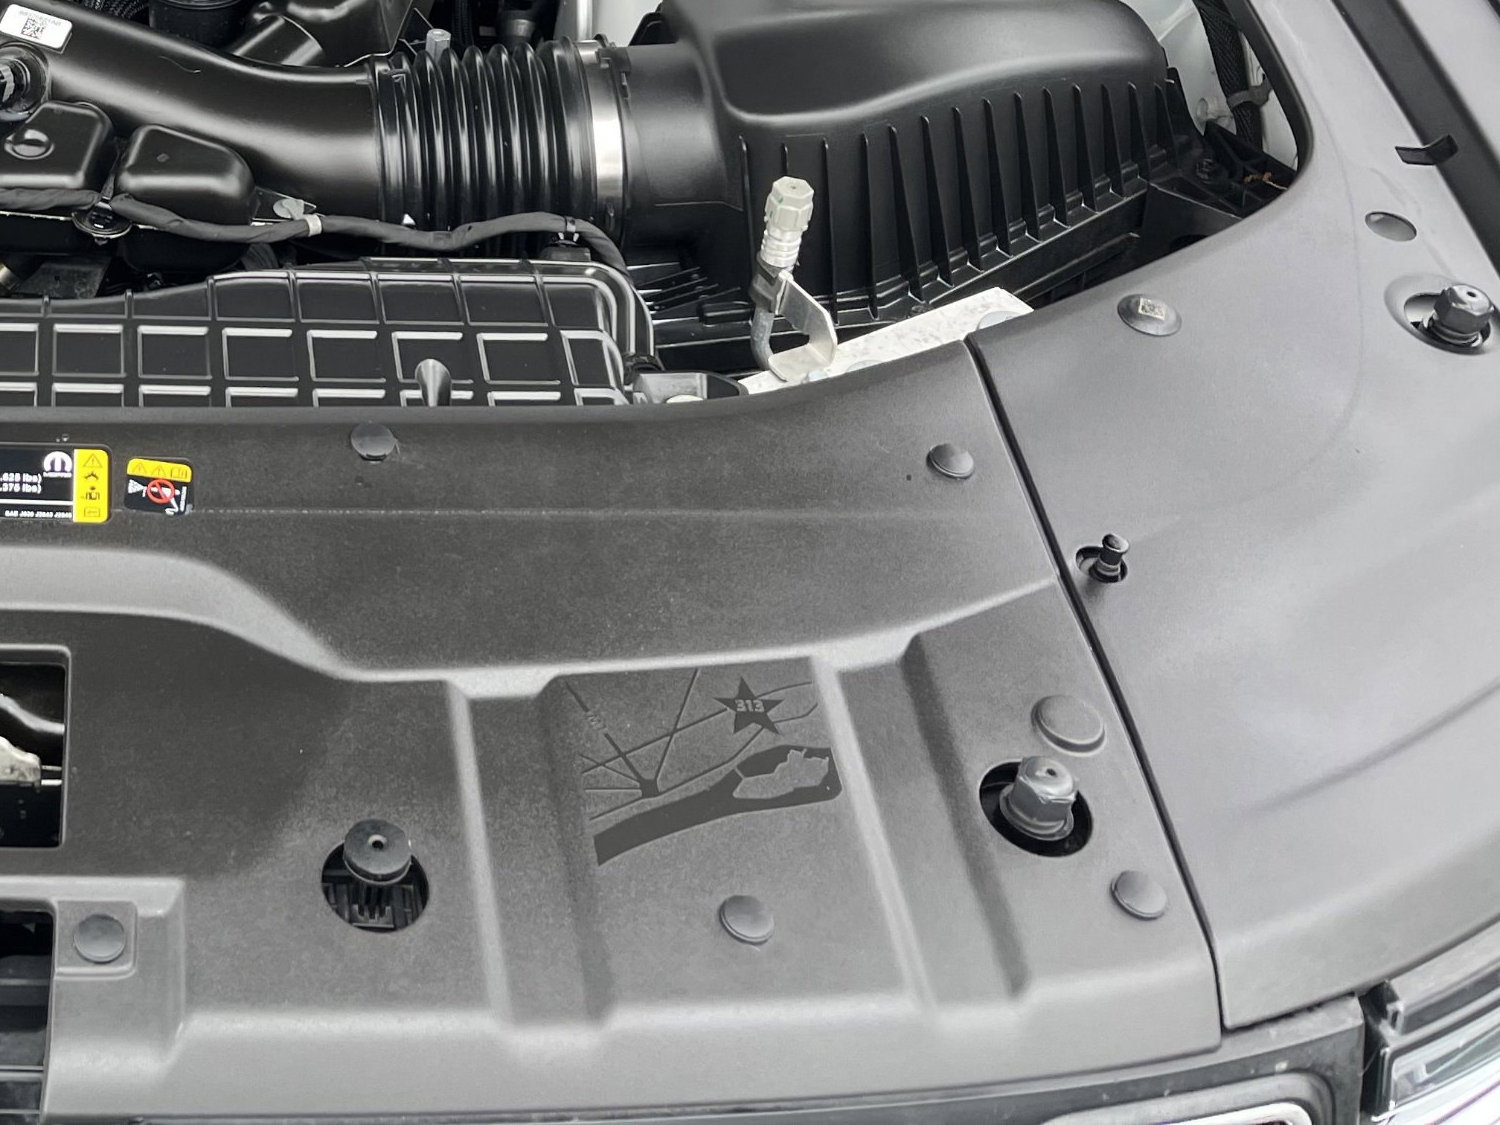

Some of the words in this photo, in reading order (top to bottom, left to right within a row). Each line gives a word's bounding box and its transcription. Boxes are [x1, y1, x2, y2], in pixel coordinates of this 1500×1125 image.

[22, 473, 42, 484] lbs)
[22, 483, 42, 494] lbs)
[734, 699, 765, 713] 313
